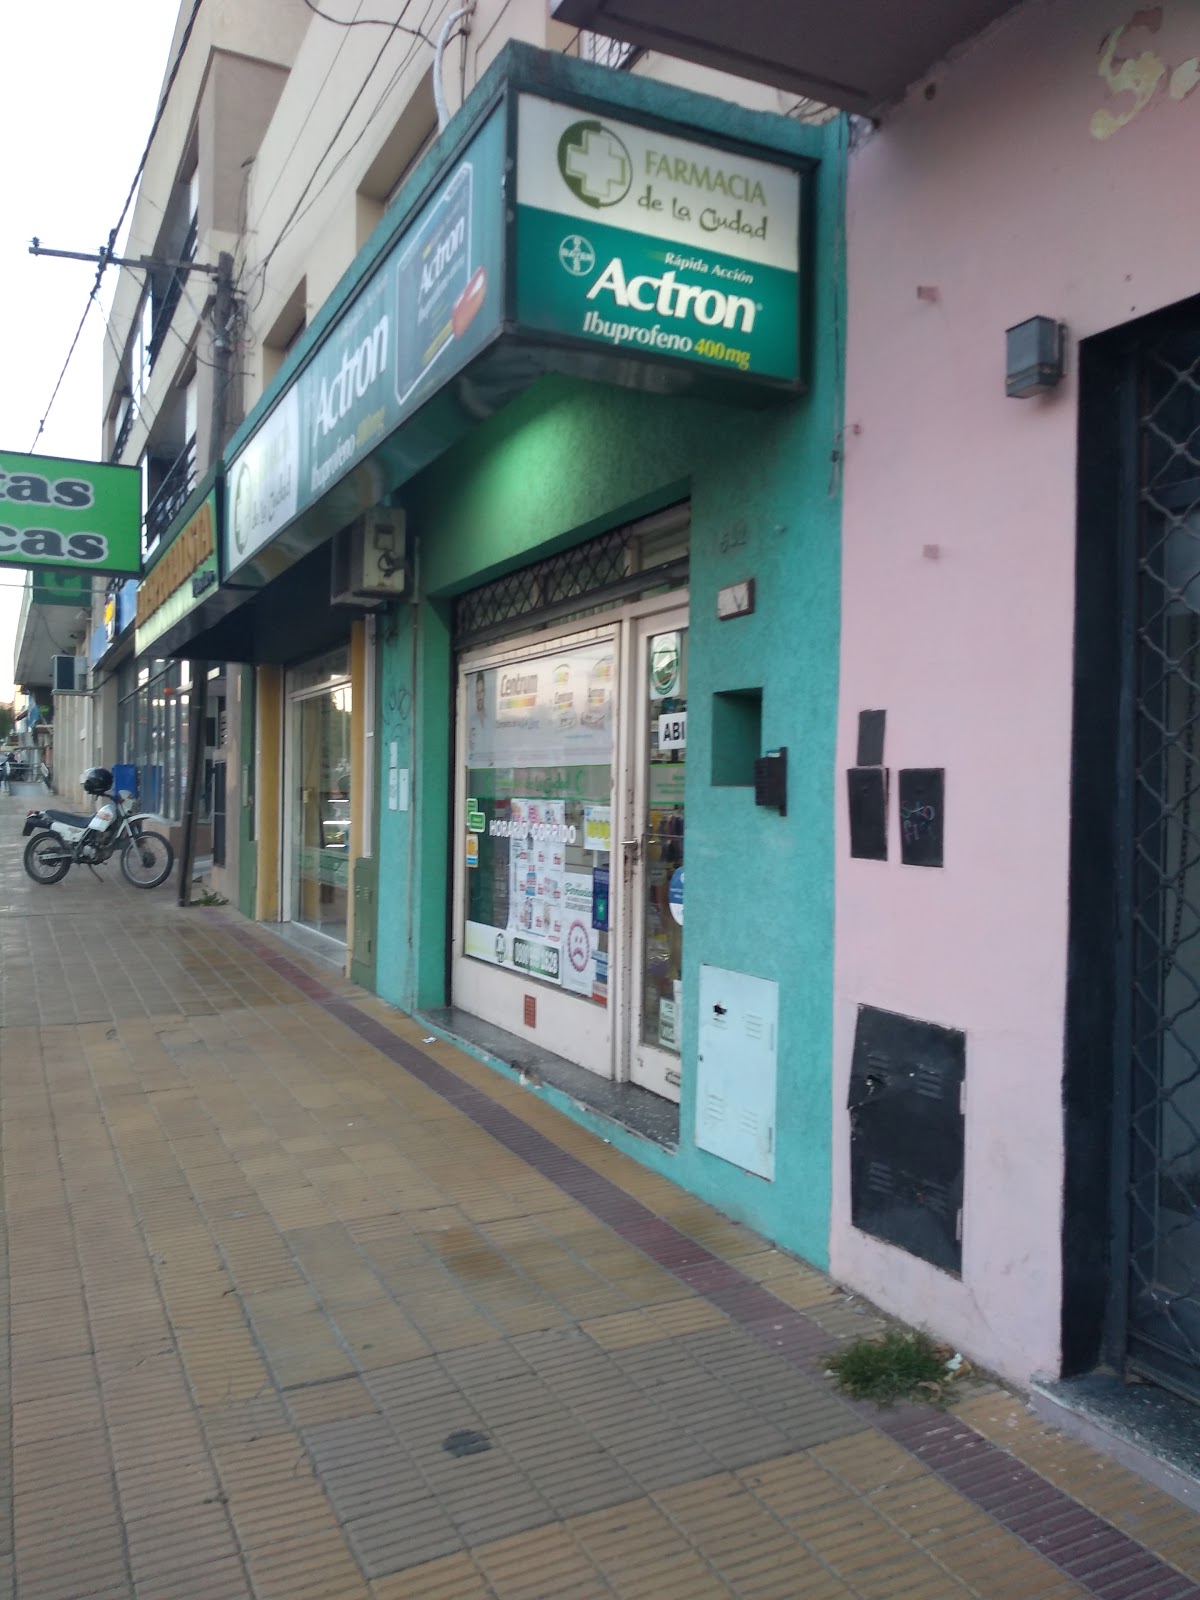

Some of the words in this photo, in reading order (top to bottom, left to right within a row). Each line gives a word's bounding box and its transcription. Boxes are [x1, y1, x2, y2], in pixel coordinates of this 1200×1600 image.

[645, 150, 767, 207] FARMACIA
[637, 184, 664, 212] de
[672, 196, 692, 222] la
[699, 207, 769, 241] Ciudad
[585, 256, 758, 335] Actron
[664, 252, 709, 272] Rápida
[711, 264, 755, 285] Acción
[582, 310, 693, 353] Ibuprofeno
[312, 314, 389, 447] Actron
